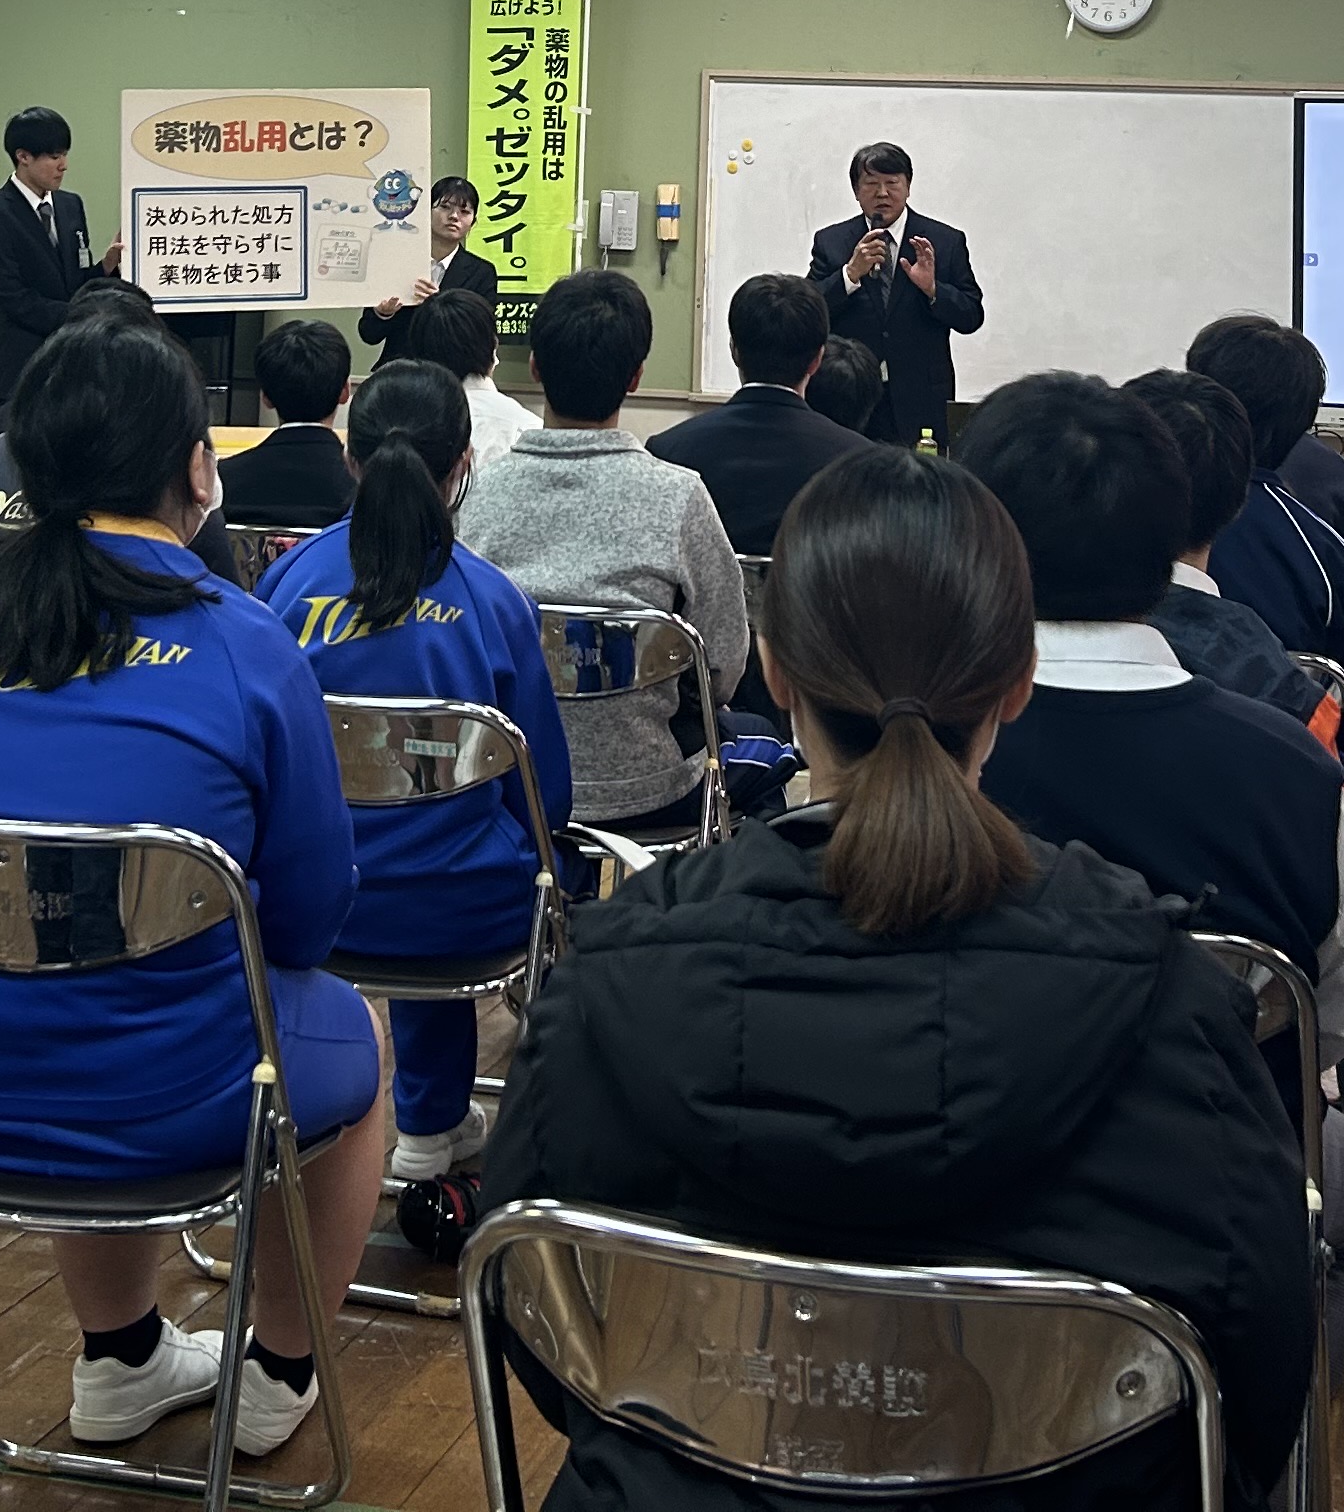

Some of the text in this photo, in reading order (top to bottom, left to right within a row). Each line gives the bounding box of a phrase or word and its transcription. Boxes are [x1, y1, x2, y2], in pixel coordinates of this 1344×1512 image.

[490, 0, 562, 16] 広げよう！
[1091, 8, 1098, 19] 7
[1104, 11, 1112, 21] 6
[1119, 9, 1127, 19] 5
[542, 28, 570, 181] 薬物の乱用は
[154, 120, 373, 153] 薬物乱用とは？
[145, 204, 294, 227] 決められた処方
[147, 233, 294, 257] 用法を守らずに
[158, 262, 282, 286] 薬物を使う事
